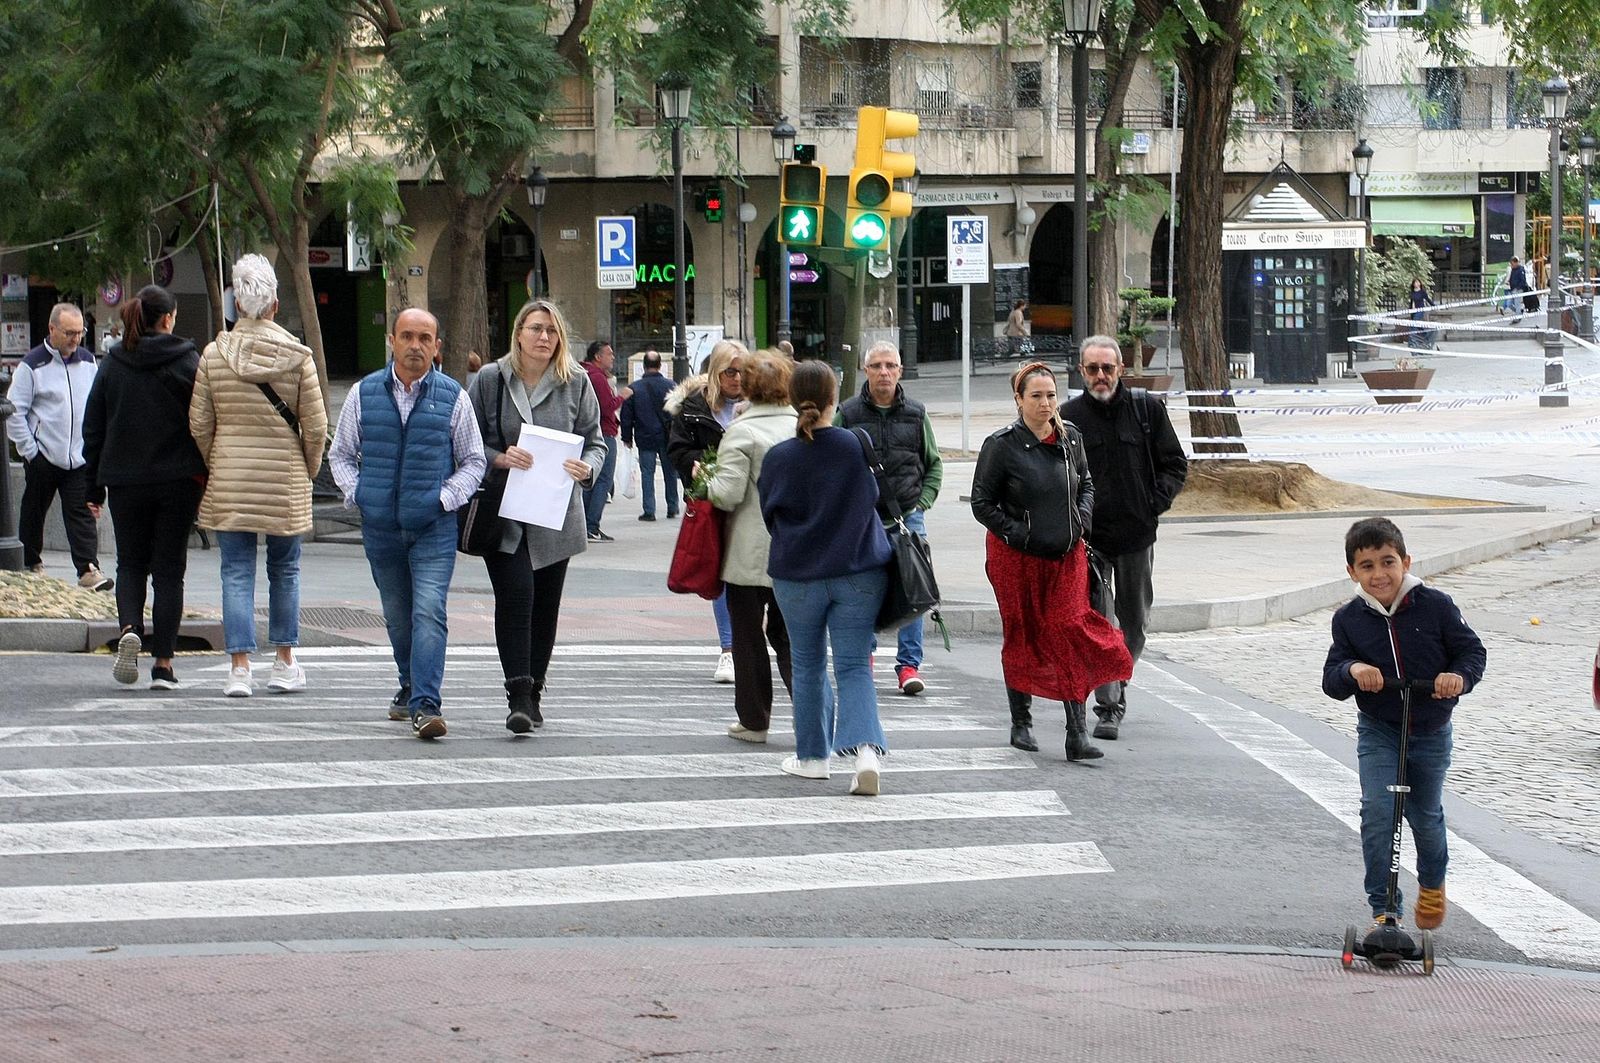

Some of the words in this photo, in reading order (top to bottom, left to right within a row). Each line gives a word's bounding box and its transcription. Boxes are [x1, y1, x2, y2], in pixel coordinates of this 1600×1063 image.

[918, 193, 946, 204] FARMACIA
[947, 193, 955, 202] DE
[965, 191, 991, 201] PALMERA
[602, 223, 626, 262] P
[1258, 232, 1289, 244] Centro
